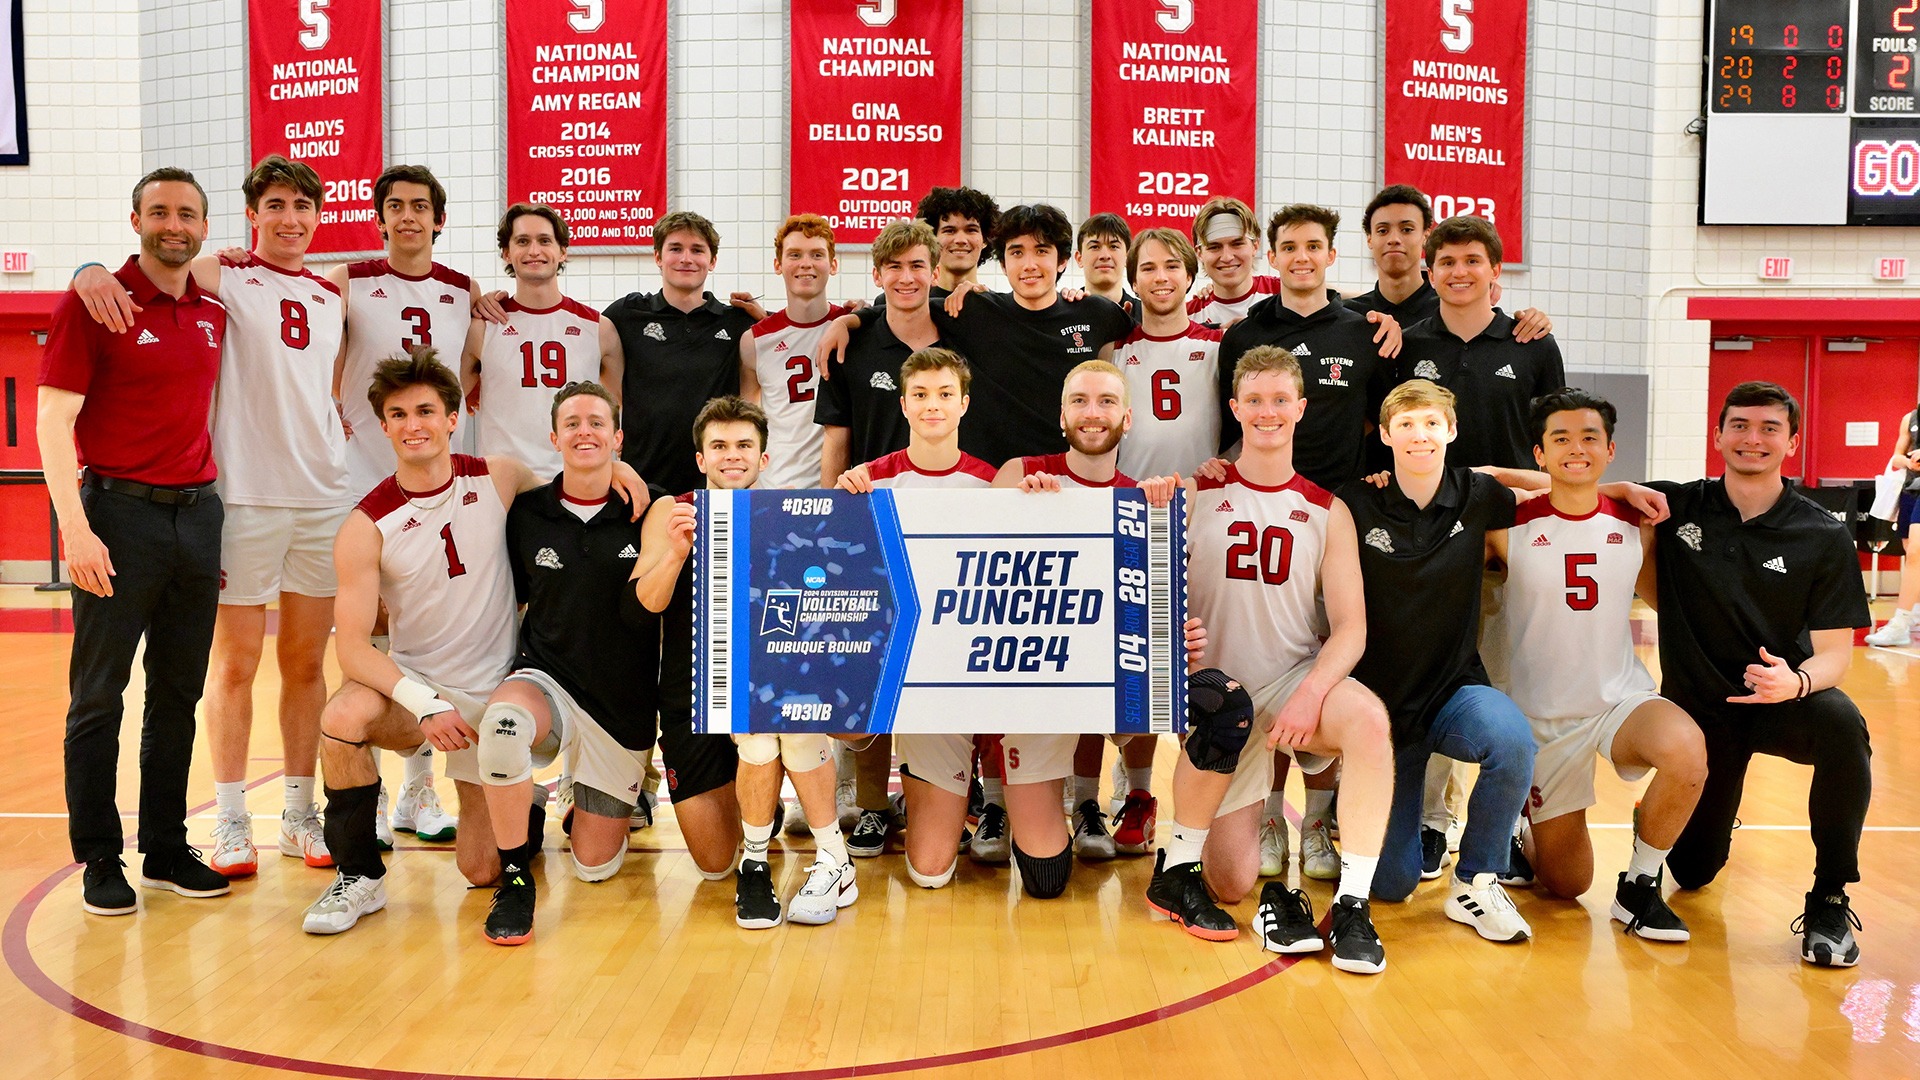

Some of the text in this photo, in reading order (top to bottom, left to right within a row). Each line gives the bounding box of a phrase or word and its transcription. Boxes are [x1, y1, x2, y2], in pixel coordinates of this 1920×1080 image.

[1731, 24, 1843, 48] 19 0 0
[1872, 37, 1917, 53] FOULS
[536, 42, 638, 62] NATIONAL
[823, 38, 932, 56] NATIONAL
[1122, 42, 1228, 63] NATIONAL
[273, 57, 357, 81] NATIONAL
[532, 63, 640, 84] CHAMPION
[819, 59, 934, 77] CHAMPION
[1119, 63, 1230, 84] CHAMPION
[1412, 60, 1501, 84] NATIONAL
[1720, 55, 1842, 80] 20 2 0
[1888, 55, 1911, 89] 2
[270, 76, 359, 101] CHAMPION
[1402, 80, 1508, 105] CHAMPIONS
[1720, 84, 1752, 108] 29
[1781, 84, 1797, 108] 8
[1825, 84, 1841, 108] 0
[530, 91, 641, 112] AMY REGAN
[851, 102, 901, 121] GINA
[1869, 96, 1915, 112] SCORE
[1143, 107, 1205, 127] BRETT
[285, 118, 345, 139] GLADYS
[560, 121, 611, 141] 2014
[809, 124, 943, 142] DELLO RUSSO
[1132, 128, 1215, 148] KALINER
[1430, 123, 1482, 144] MEN'S
[290, 139, 340, 160] NJOKU
[529, 143, 642, 159] CROSS COUNTRY
[1404, 143, 1506, 166] VOLLEYBALL
[561, 167, 611, 186] 2016
[1854, 140, 1920, 196] GO
[842, 167, 909, 191] 2021
[1138, 171, 1209, 196] 2022
[324, 178, 373, 203] 2016
[529, 189, 642, 204] CROSS COUNTRY
[320, 208, 376, 224] GH JUMP
[563, 208, 597, 222] 3,000
[598, 209, 618, 220] AND
[620, 207, 654, 222] 5,000
[839, 199, 912, 214] OUTDOOR
[1125, 202, 1204, 218] 149 POUN
[601, 227, 621, 238] AND
[623, 225, 654, 240] 10,00
[4, 252, 28, 271] EXIT
[1765, 258, 1790, 277] EXIT
[1881, 259, 1905, 278] EXIT
[279, 297, 311, 350] 8
[401, 306, 432, 353] 3
[1060, 324, 1091, 336] STEVENS
[1066, 346, 1093, 354] VOLLEYBALL
[1073, 332, 1084, 348] S
[519, 340, 567, 388] 19
[1319, 356, 1354, 368] STEVENS
[1330, 363, 1342, 380] S
[785, 355, 815, 403] 2
[1318, 378, 1349, 387] VOLLEYBALL
[1151, 369, 1182, 421] 6
[781, 497, 833, 516] #D3VB
[440, 521, 467, 579] 1
[1225, 520, 1294, 586] 20
[956, 551, 1079, 587] TICKET
[1564, 552, 1599, 611] 5
[802, 597, 879, 612] VOLLEYBALL
[932, 589, 1104, 625] PUNCHED
[1117, 500, 1147, 724] SECTION 04 ROW 28 SEAT 24
[799, 612, 869, 623] CHAMPIONSHIP
[766, 640, 872, 656] DUBUQUE BOUND
[966, 636, 1070, 673] 2024
[780, 702, 833, 721] #D3VB
[1008, 747, 1021, 770] S
[1530, 785, 1543, 809] S
